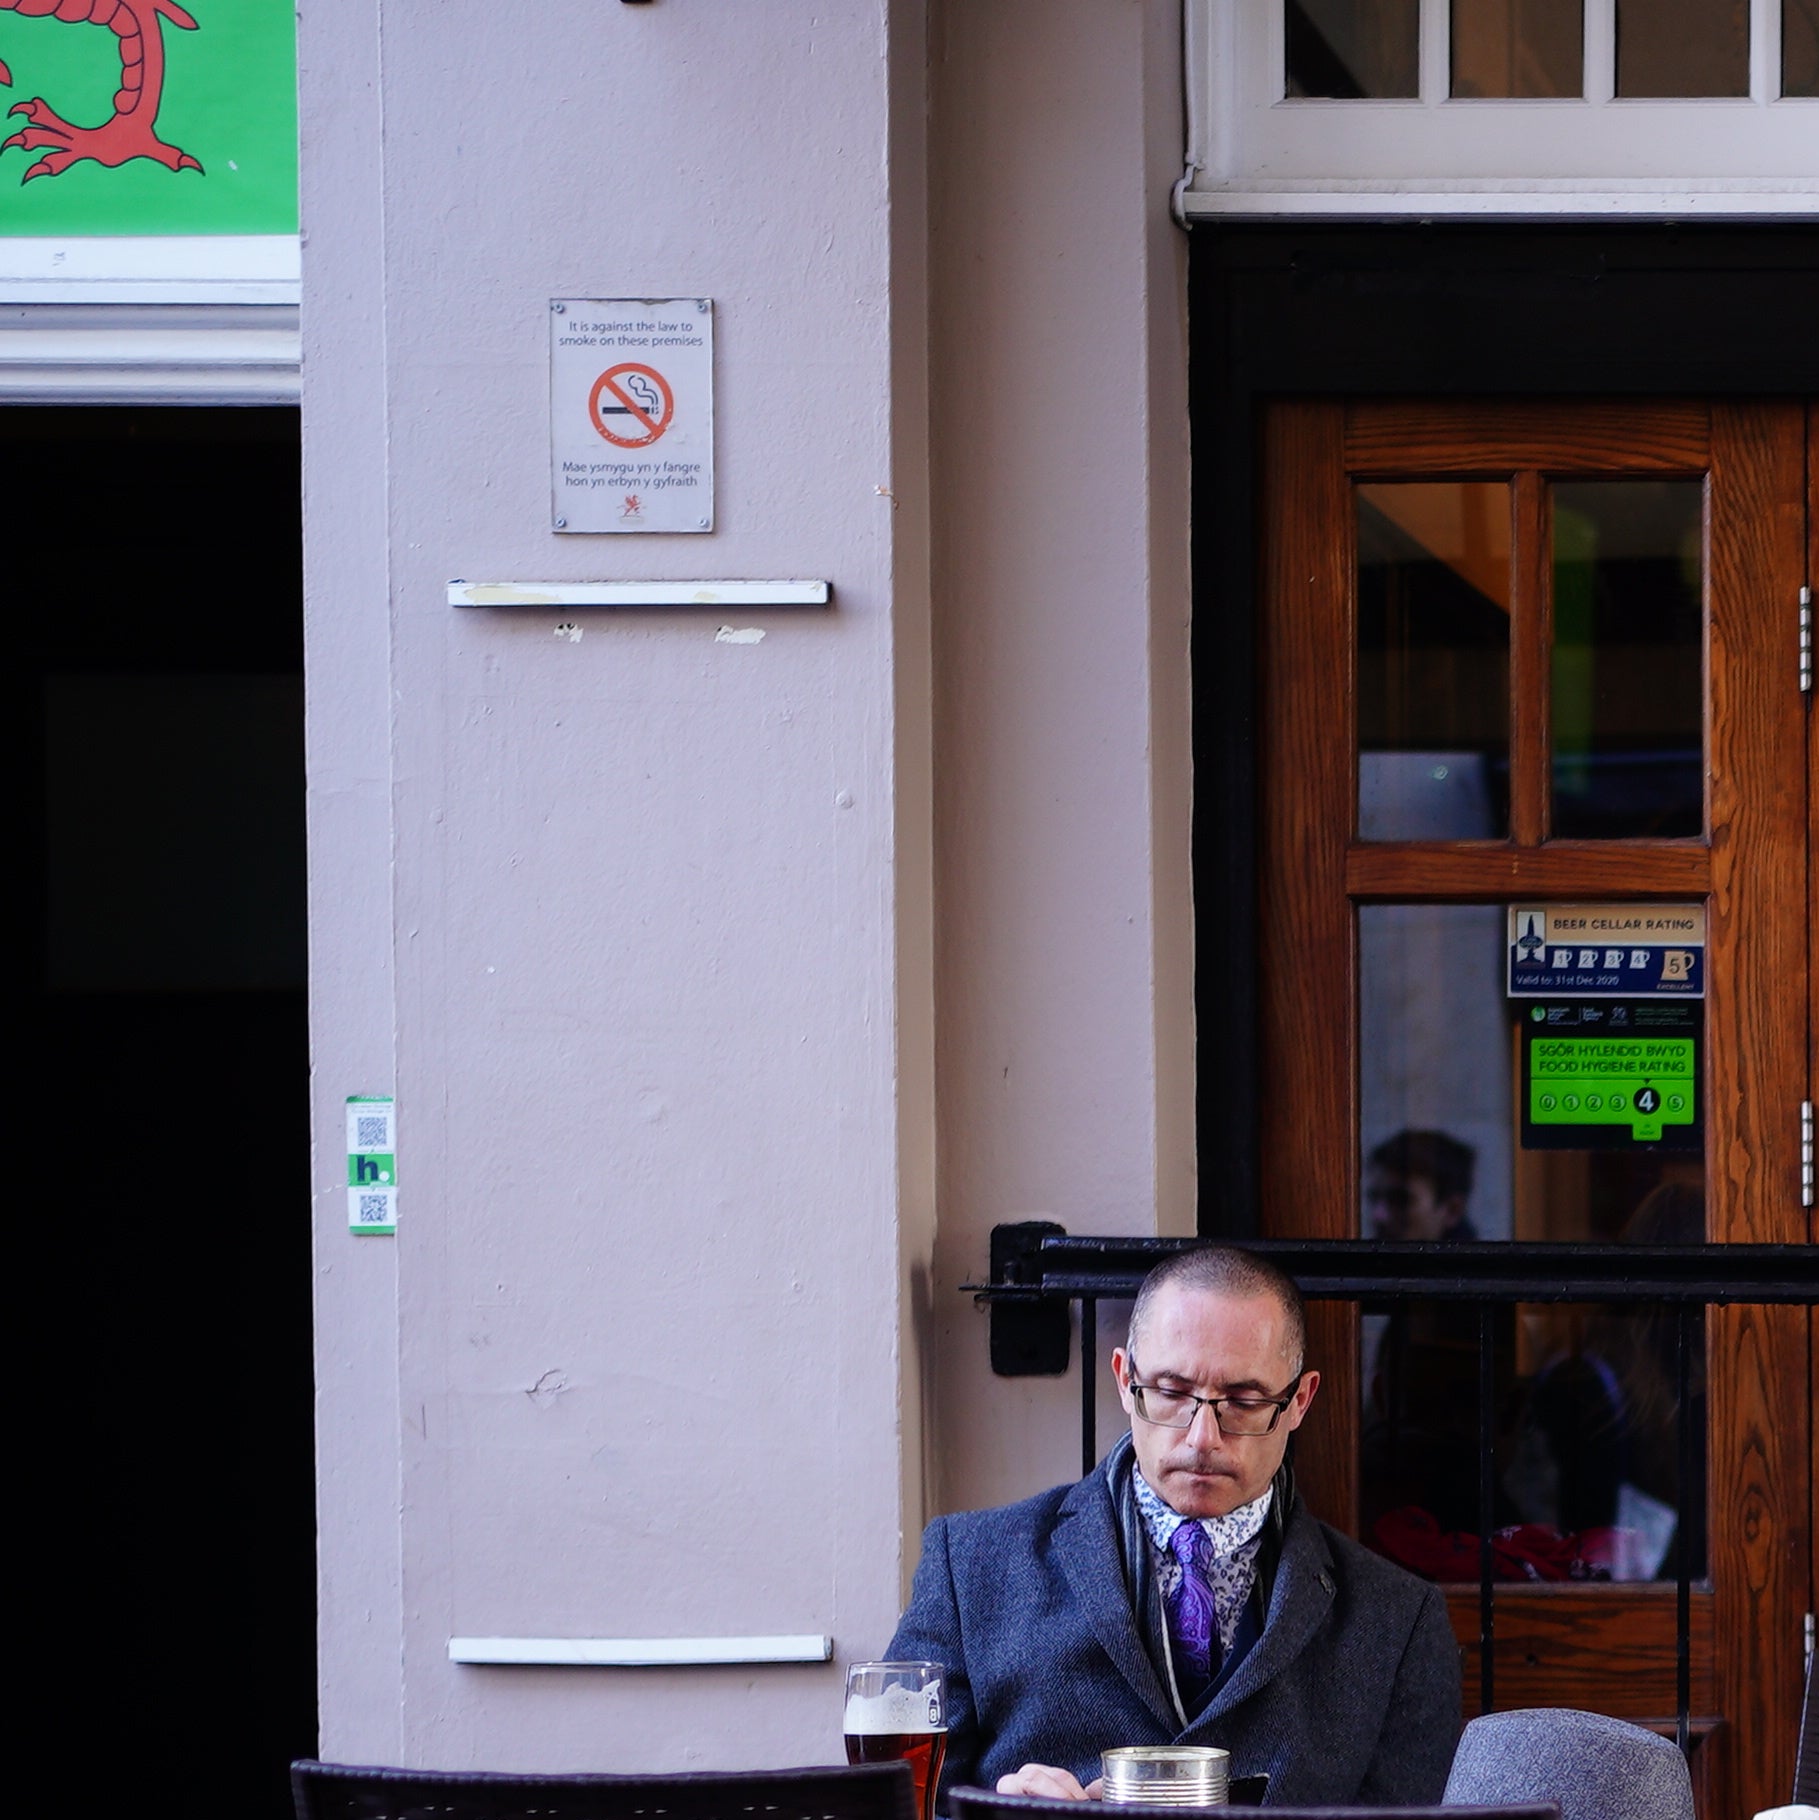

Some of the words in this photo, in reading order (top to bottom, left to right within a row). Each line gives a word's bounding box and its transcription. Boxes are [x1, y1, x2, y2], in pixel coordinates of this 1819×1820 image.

[569, 321, 577, 332] It
[581, 321, 589, 332] is
[591, 321, 633, 335] against
[636, 321, 655, 332] the
[658, 321, 678, 332] law
[681, 322, 693, 332] to
[559, 335, 597, 347] smoke
[599, 338, 615, 347] on
[618, 335, 649, 347] these
[652, 335, 704, 349] premises
[562, 461, 587, 473] Mae
[589, 463, 634, 475] ysmygu
[637, 463, 651, 475] yn
[654, 463, 662, 475] y
[663, 461, 701, 475] fangre
[565, 476, 588, 487] hon
[591, 478, 605, 489] yn
[608, 476, 641, 489] erbyn
[644, 478, 652, 489] y
[653, 475, 698, 490] gyfraith
[1553, 918, 1587, 931] BEER
[1591, 918, 1642, 931] CELLAR
[1645, 918, 1695, 931] RATING
[1669, 958, 1681, 974] 5
[1516, 974, 1540, 986] Valid
[1555, 974, 1575, 986] 31st
[1576, 974, 1594, 986] Dec
[1539, 1061, 1578, 1073] FOOD
[1581, 1061, 1636, 1073] HYGIENE
[1639, 1061, 1686, 1073] RATING
[1638, 1090, 1655, 1112] 4
